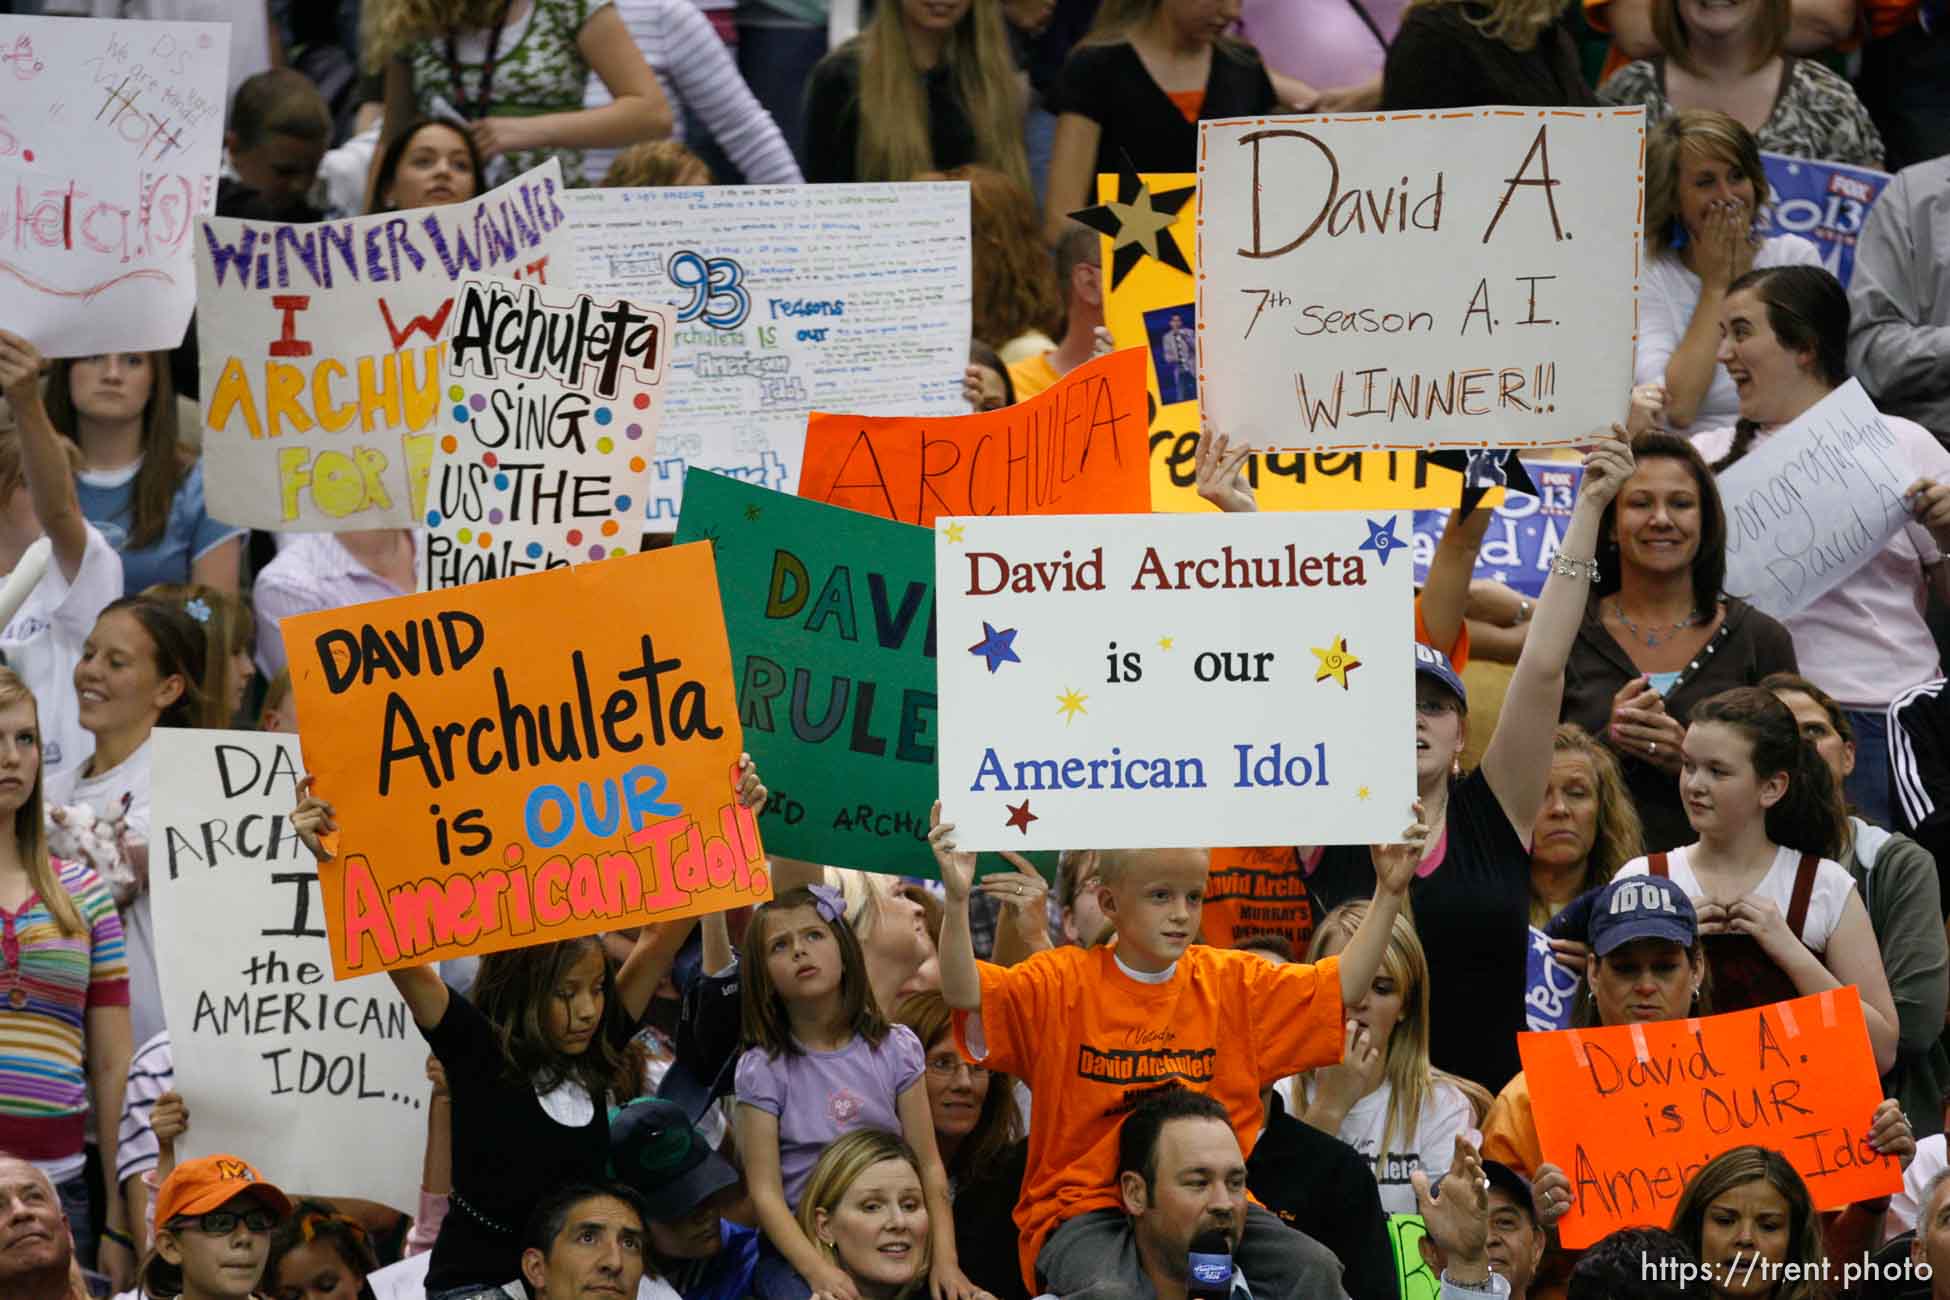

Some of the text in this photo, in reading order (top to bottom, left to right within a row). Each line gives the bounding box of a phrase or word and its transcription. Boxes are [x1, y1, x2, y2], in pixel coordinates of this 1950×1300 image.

[1236, 123, 1573, 259] David A.
[1823, 195, 1864, 232] 13
[1833, 175, 1871, 200] FOX
[668, 250, 751, 331] 93
[769, 298, 845, 320] reasons
[1241, 289, 1292, 339] 7th
[269, 295, 312, 357] I
[452, 285, 659, 396] Archuleta
[674, 327, 745, 348] rchuleta
[207, 340, 448, 440] ARCHU
[1294, 361, 1556, 433] WINNER!!
[823, 375, 1132, 527] ARCHULETA
[1543, 472, 1574, 485] FOX
[279, 443, 393, 522] FOR
[440, 463, 488, 522] US
[500, 463, 612, 525] THE
[1544, 485, 1573, 508] 13
[427, 533, 571, 591] PHON
[964, 547, 1106, 596] David
[1131, 544, 1367, 591] Archuleta
[1765, 504, 1874, 596] David
[765, 549, 937, 651] DAVI
[315, 611, 484, 695] DAVID
[1106, 641, 1275, 683] is our
[379, 634, 724, 797] Archuleta
[740, 655, 937, 766] RULE
[215, 744, 299, 799] DA
[970, 742, 1330, 792] American Idol
[430, 764, 684, 865] is OUR
[832, 804, 932, 843] ARCHU
[166, 814, 299, 880] ARCH
[343, 764, 768, 970] American Idol!
[1610, 881, 1677, 914] IDOL
[242, 951, 325, 986] the
[192, 991, 407, 1040] AMERICAN
[1081, 1050, 1134, 1079] David
[1583, 1012, 1809, 1097] David A.
[1643, 1079, 1815, 1137] is OUR
